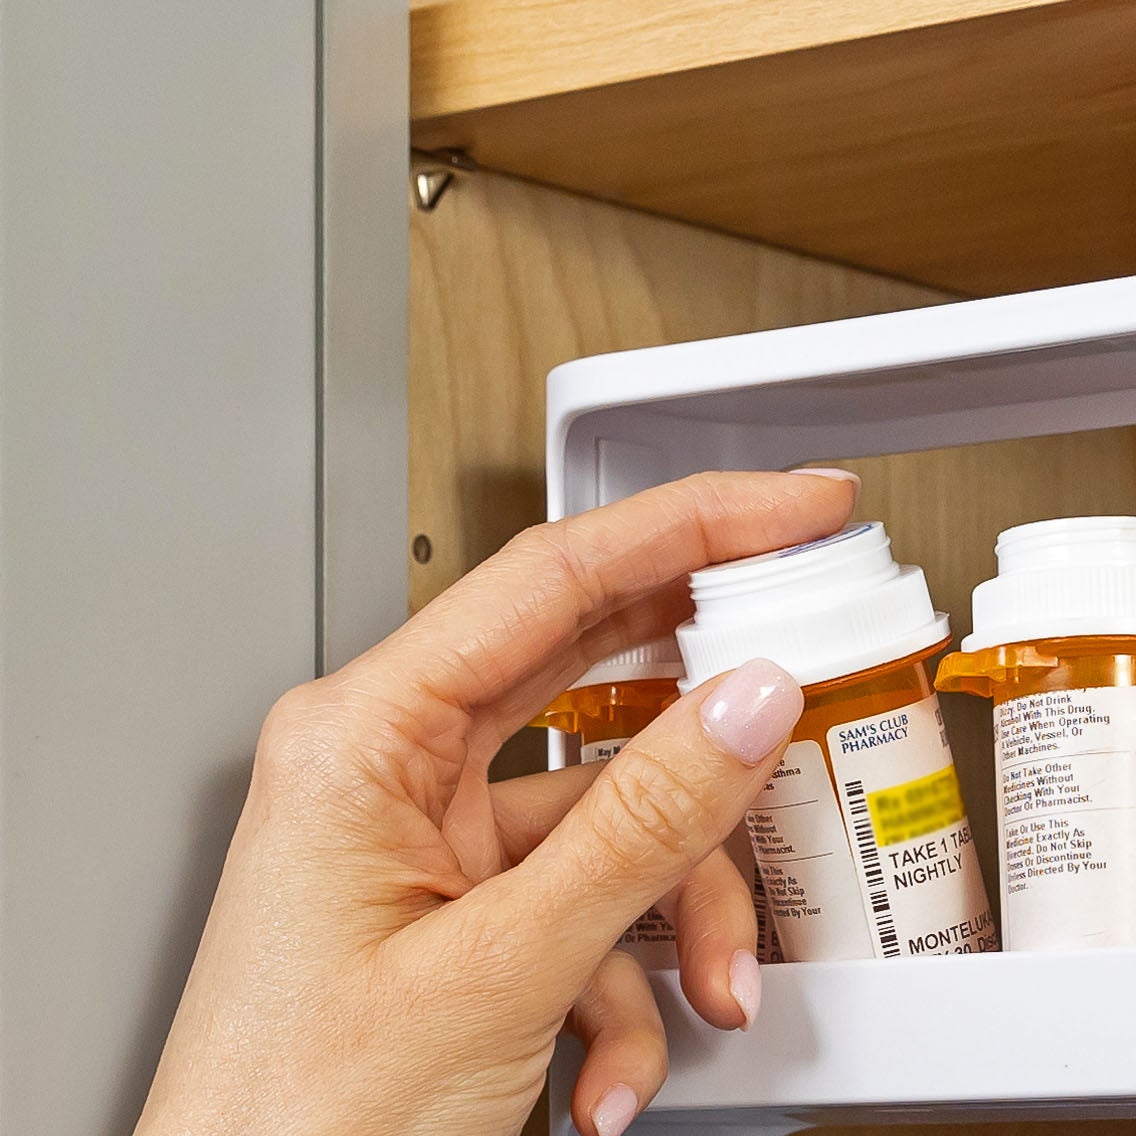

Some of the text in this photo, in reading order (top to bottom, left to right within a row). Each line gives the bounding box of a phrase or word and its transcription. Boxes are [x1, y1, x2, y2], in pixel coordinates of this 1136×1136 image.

[1017, 695, 1072, 711] Do Not Drink
[1023, 705, 1095, 721] With This Drug.
[839, 714, 908, 742] SAM'S CLUB
[1029, 715, 1110, 731] When Operating
[842, 726, 909, 754] PHARMACY
[772, 767, 801, 779] sthma
[889, 841, 938, 869] TAKE
[941, 838, 948, 852] 1
[894, 854, 962, 890] NIGHTLY
[801, 908, 821, 917] Your
